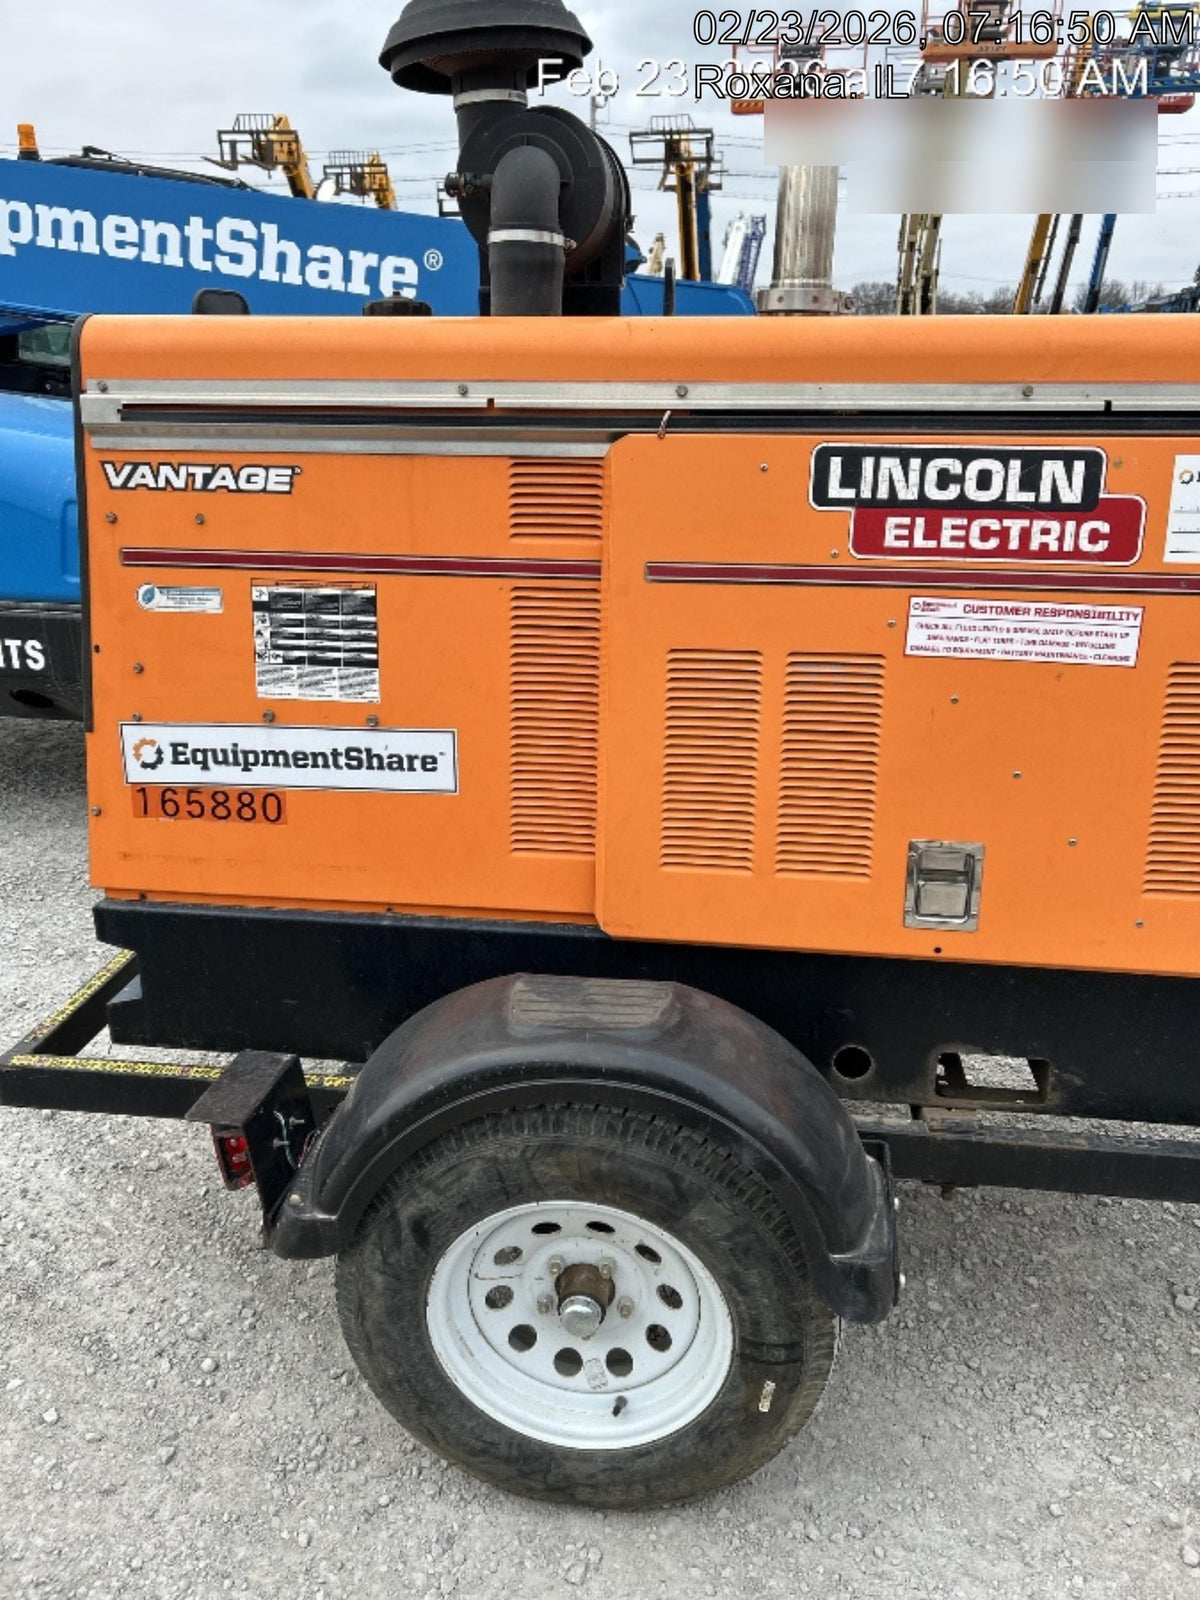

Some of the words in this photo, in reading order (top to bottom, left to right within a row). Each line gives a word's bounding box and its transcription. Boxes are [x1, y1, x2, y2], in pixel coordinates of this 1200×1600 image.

[827, 456, 1086, 504] LINCOLN
[883, 516, 1110, 553] ELECTRIC
[963, 603, 1031, 616] CUSTOMER
[0, 638, 45, 671] TS
[170, 742, 439, 772] EquipmentShare
[136, 786, 282, 824] 165880
